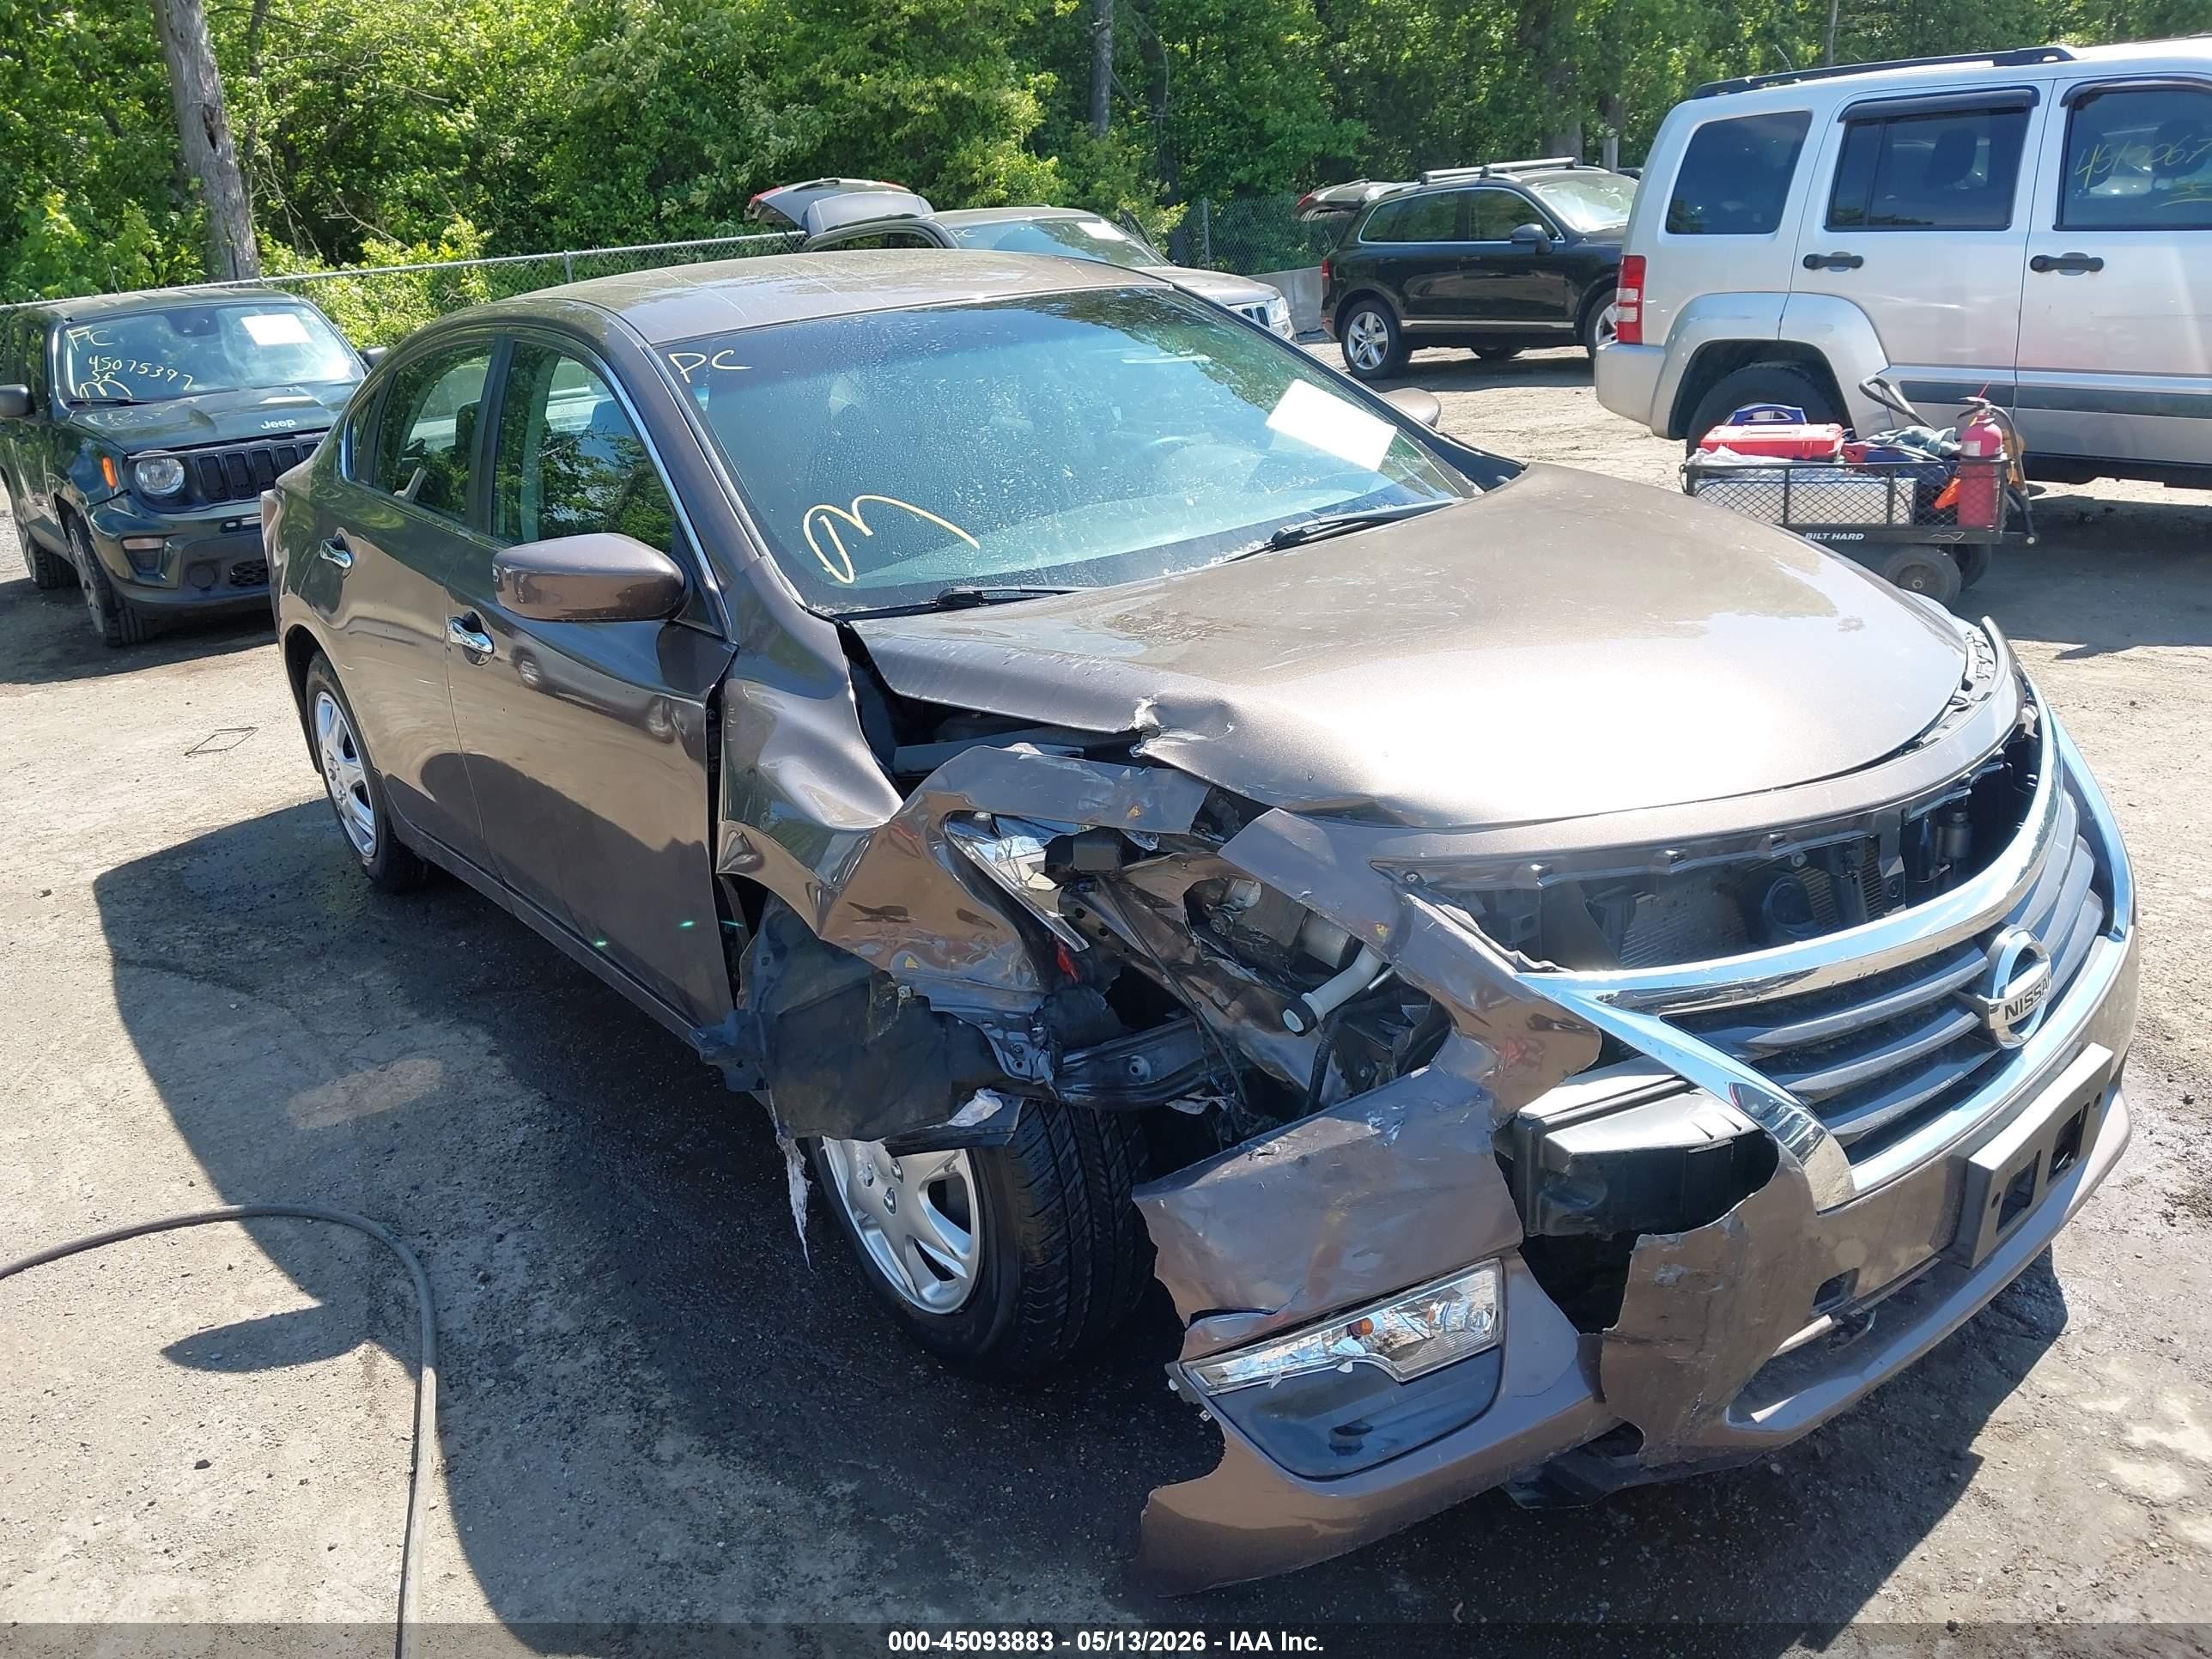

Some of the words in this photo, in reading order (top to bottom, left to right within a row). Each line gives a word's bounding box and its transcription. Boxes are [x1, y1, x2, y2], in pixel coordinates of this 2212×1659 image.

[668, 349, 754, 384] PC
[260, 419, 296, 429] Jeep
[1831, 532, 1865, 541] HARD
